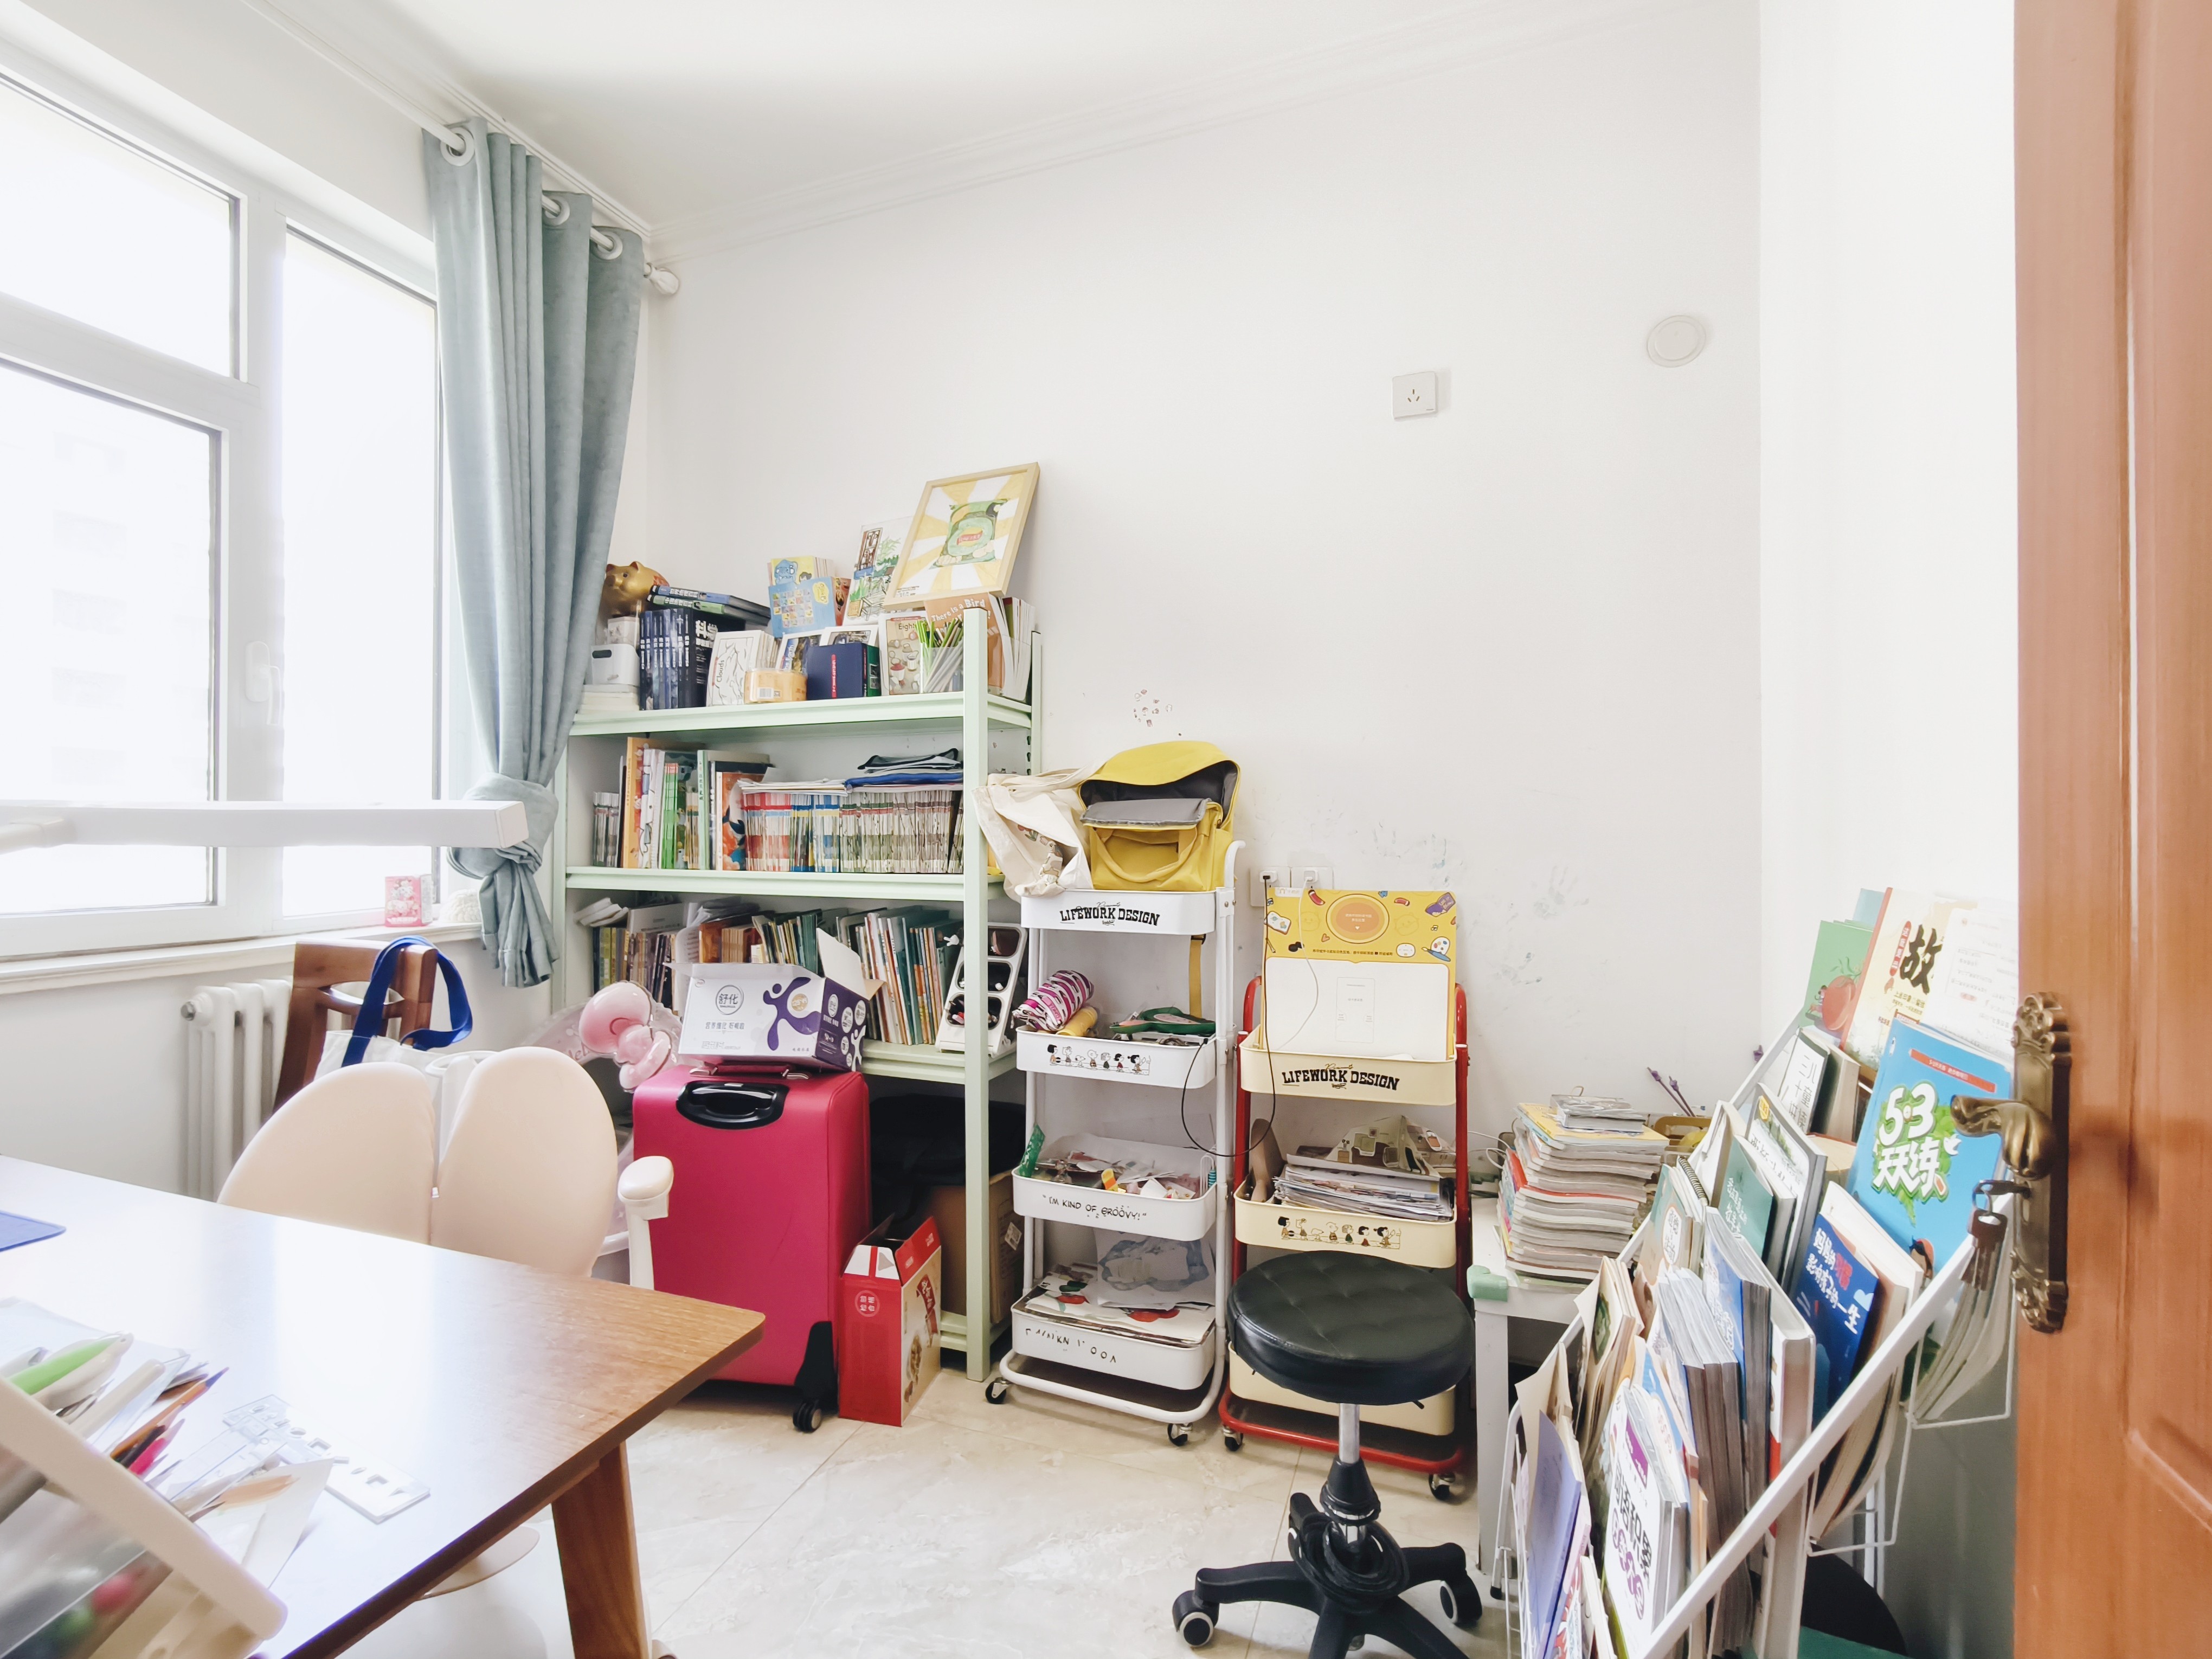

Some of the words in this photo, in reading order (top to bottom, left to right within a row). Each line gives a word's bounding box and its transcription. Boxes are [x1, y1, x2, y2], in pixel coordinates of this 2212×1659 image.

[931, 611, 951, 622] There
[964, 599, 986, 608] Bird
[716, 659, 724, 683] Clouds
[1060, 907, 1116, 921] LIFEWORK
[1117, 908, 1160, 925] DESIGN
[1900, 924, 1943, 995] 故
[718, 993, 738, 1005] 舒化
[1282, 1069, 1348, 1083] LIFEWORK
[1350, 1071, 1400, 1090] DESIGN
[1063, 1199, 1081, 1209] KIND
